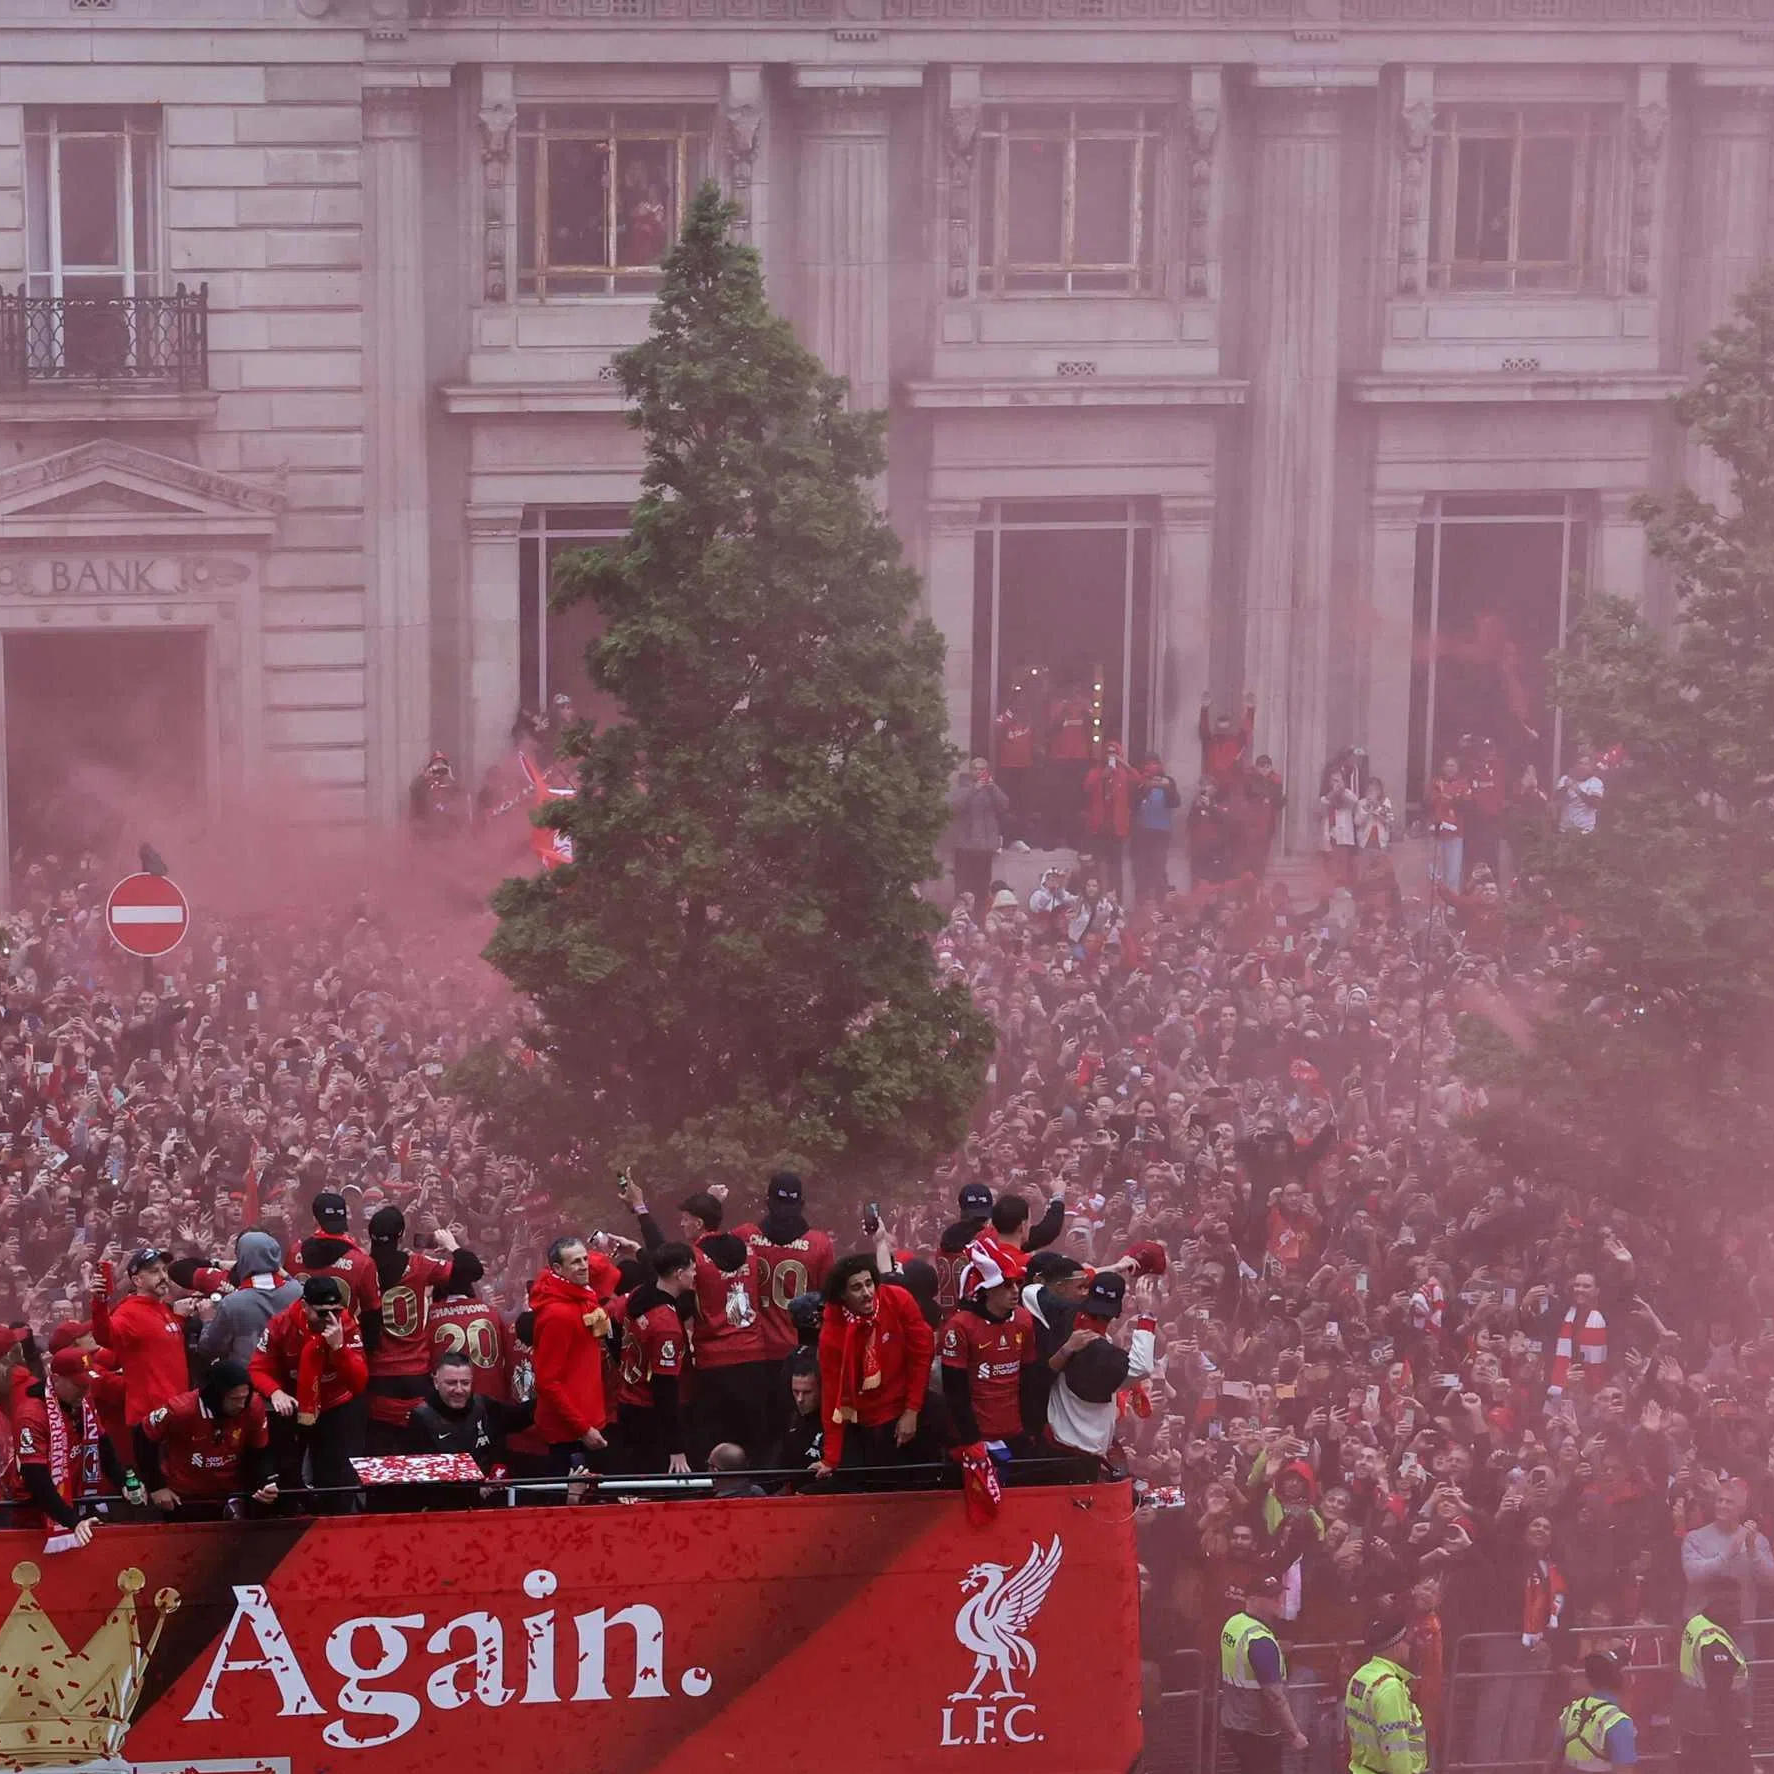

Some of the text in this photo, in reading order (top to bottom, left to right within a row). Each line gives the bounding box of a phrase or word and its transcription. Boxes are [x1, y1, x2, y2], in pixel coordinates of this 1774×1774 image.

[49, 560, 156, 592] BANK
[435, 1319, 498, 1369] 20
[182, 1568, 712, 1749] Again.
[940, 1704, 1044, 1746] L.F.C.
